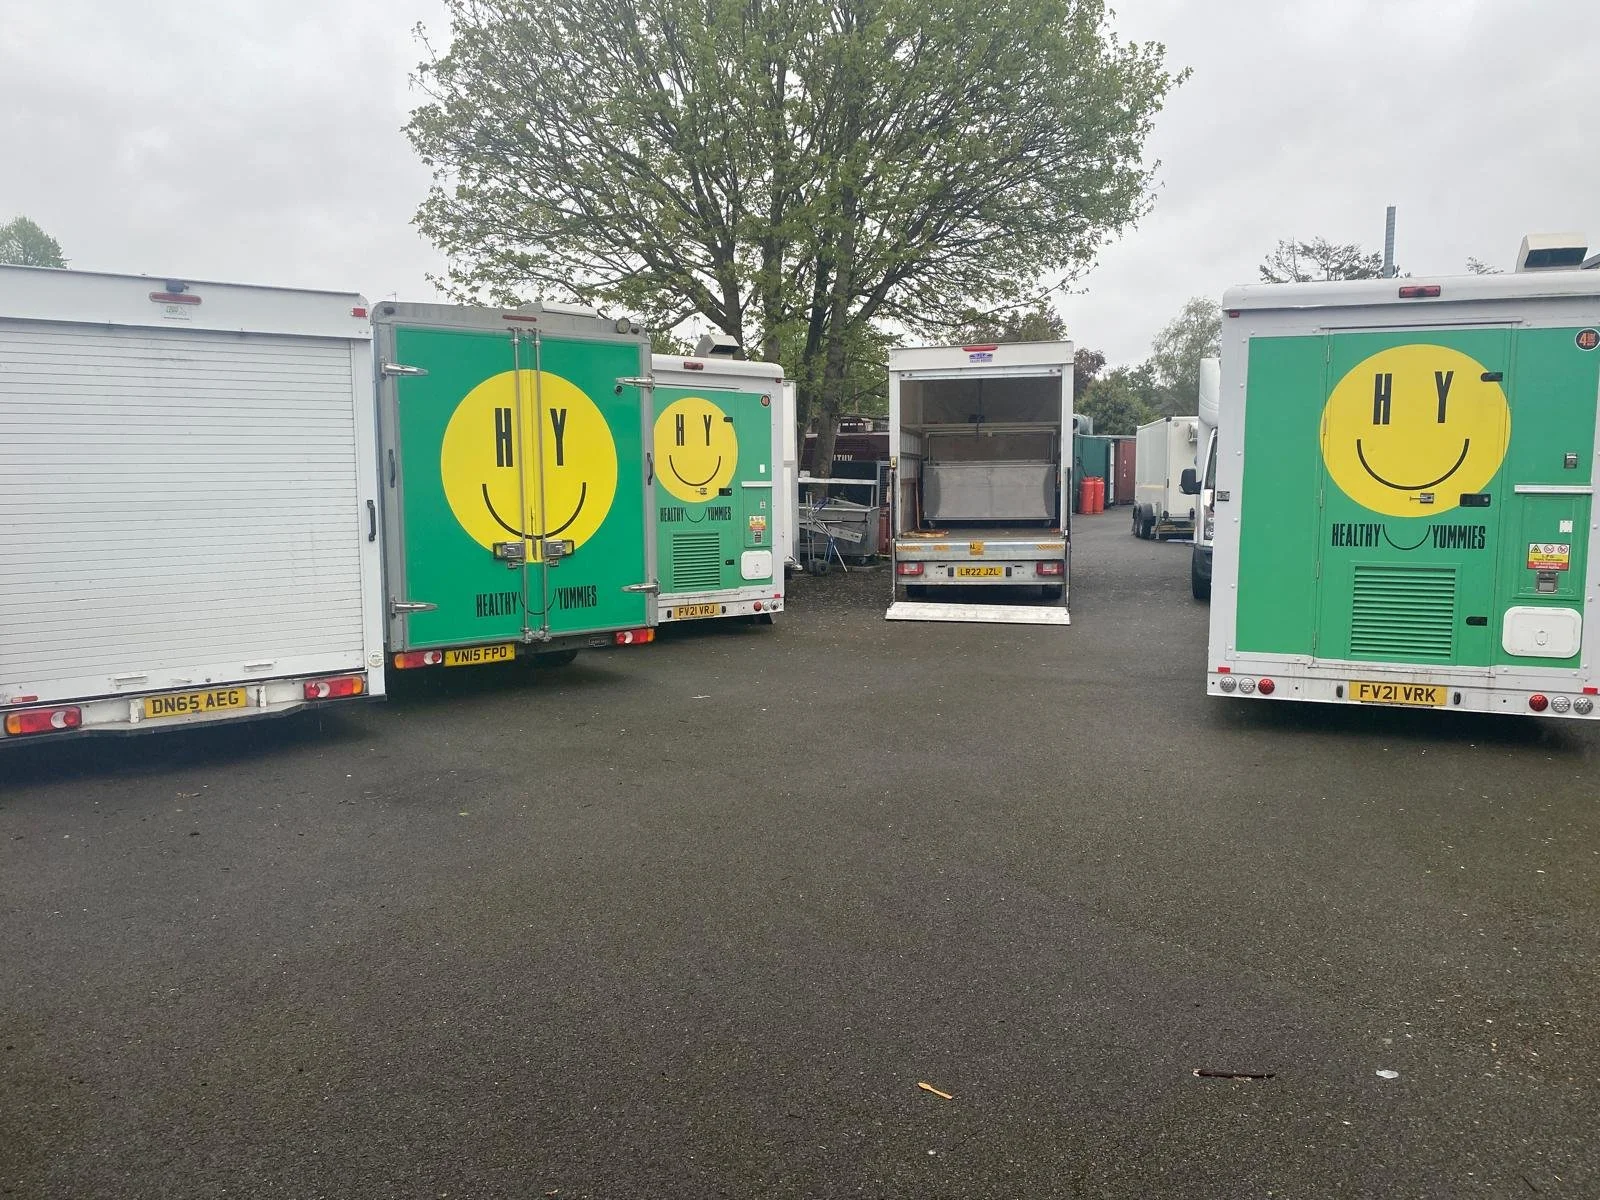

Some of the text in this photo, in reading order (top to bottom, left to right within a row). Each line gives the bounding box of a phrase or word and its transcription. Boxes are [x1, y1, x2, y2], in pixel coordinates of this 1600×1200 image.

[1373, 371, 1454, 425] H Y
[495, 408, 567, 467] H Y
[676, 414, 712, 446] H Y
[660, 506, 732, 522] HEALTHY YUMMIES
[1332, 523, 1486, 549] HEALTHY YUMMIES
[476, 585, 597, 617] HEALTHY YUMMIES
[679, 605, 715, 616] FV21 VRJ
[454, 647, 507, 662] VN15 FPO
[152, 691, 239, 714] DN65 AEG
[1360, 684, 1436, 702] FV21 VRK
